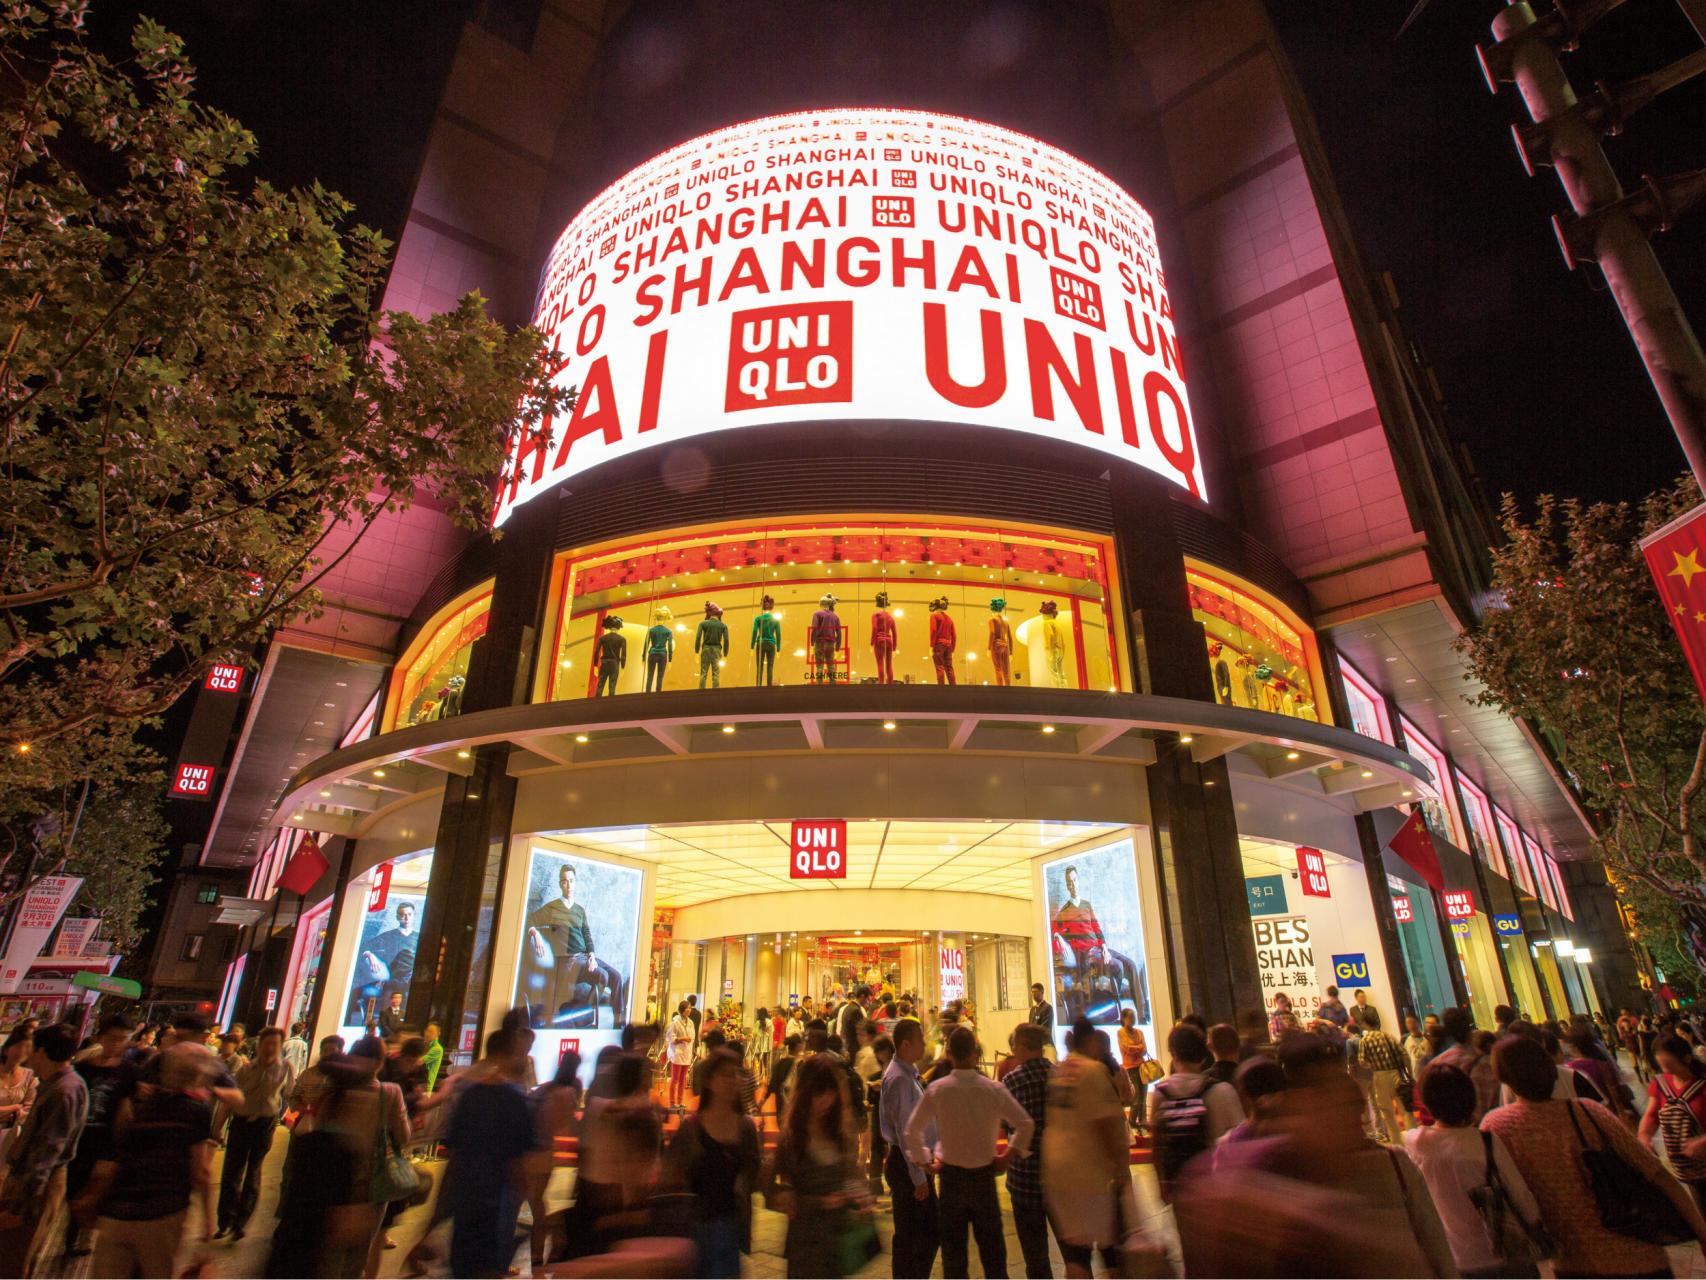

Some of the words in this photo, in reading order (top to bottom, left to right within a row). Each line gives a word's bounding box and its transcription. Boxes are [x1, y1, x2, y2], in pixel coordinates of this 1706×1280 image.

[686, 159, 755, 190] UNIQLO
[766, 148, 874, 169] SHANGHAI
[894, 171, 913, 179] UNI
[911, 149, 986, 173] UNIQLO
[995, 165, 1087, 210] SHANGHAI
[894, 179, 914, 187] QLO
[624, 191, 712, 243] UNIQLO
[725, 167, 878, 203] SHANGHAI
[876, 199, 907, 212] UNI
[585, 191, 658, 248] SHANGHAI
[875, 211, 911, 225] QLO
[930, 172, 1032, 211] UNIQLO
[1045, 200, 1152, 277] SHANGHAI
[611, 196, 847, 285] SHANGHAI
[937, 199, 1101, 274] UNIQLO
[1110, 213, 1155, 258] UNIQLO
[633, 235, 1022, 327] SHANGHAI
[1055, 274, 1094, 303] UNI
[1058, 295, 1101, 324] QLO
[741, 313, 830, 354] UNI
[738, 354, 839, 401] QLO
[491, 328, 669, 525] HAI
[210, 677, 237, 690] QLO
[213, 667, 238, 679] UNI
[178, 778, 208, 791] QLO
[181, 768, 209, 780] UNI
[796, 827, 837, 848] UNI
[796, 851, 841, 874] QLO
[1305, 854, 1323, 873] UNI
[1309, 872, 1328, 893] QLO
[28, 897, 60, 905] UNIQLO
[1445, 894, 1467, 904] UNI
[23, 912, 55, 921] 9月30日
[1448, 904, 1471, 916] QLO
[1254, 918, 1310, 946] BES
[1497, 919, 1519, 931] GU
[1257, 948, 1315, 969] SHAN
[1336, 963, 1367, 979] GU
[1265, 997, 1307, 1008] ULO
